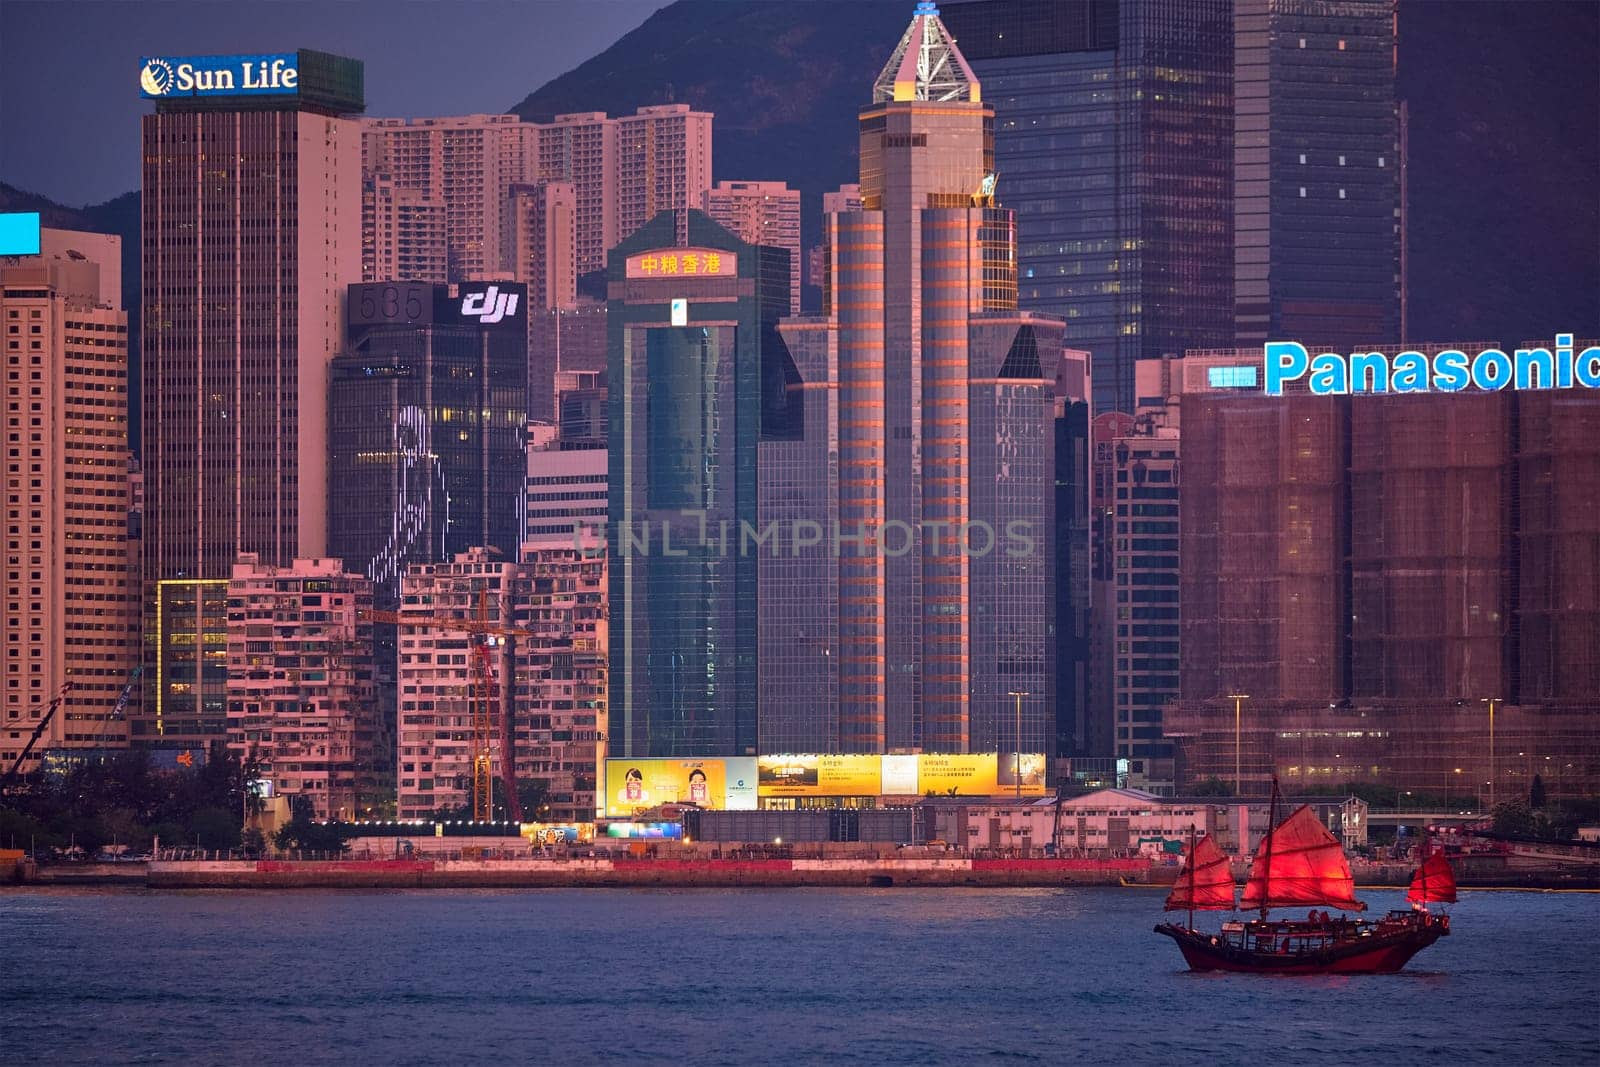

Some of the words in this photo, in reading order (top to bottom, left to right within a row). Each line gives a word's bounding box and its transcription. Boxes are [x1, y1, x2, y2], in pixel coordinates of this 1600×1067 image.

[177, 64, 235, 91] Sun
[242, 59, 298, 89] Life
[641, 253, 721, 275] 中粮香港
[360, 286, 423, 319] 535
[1264, 333, 1600, 395] Panasonic
